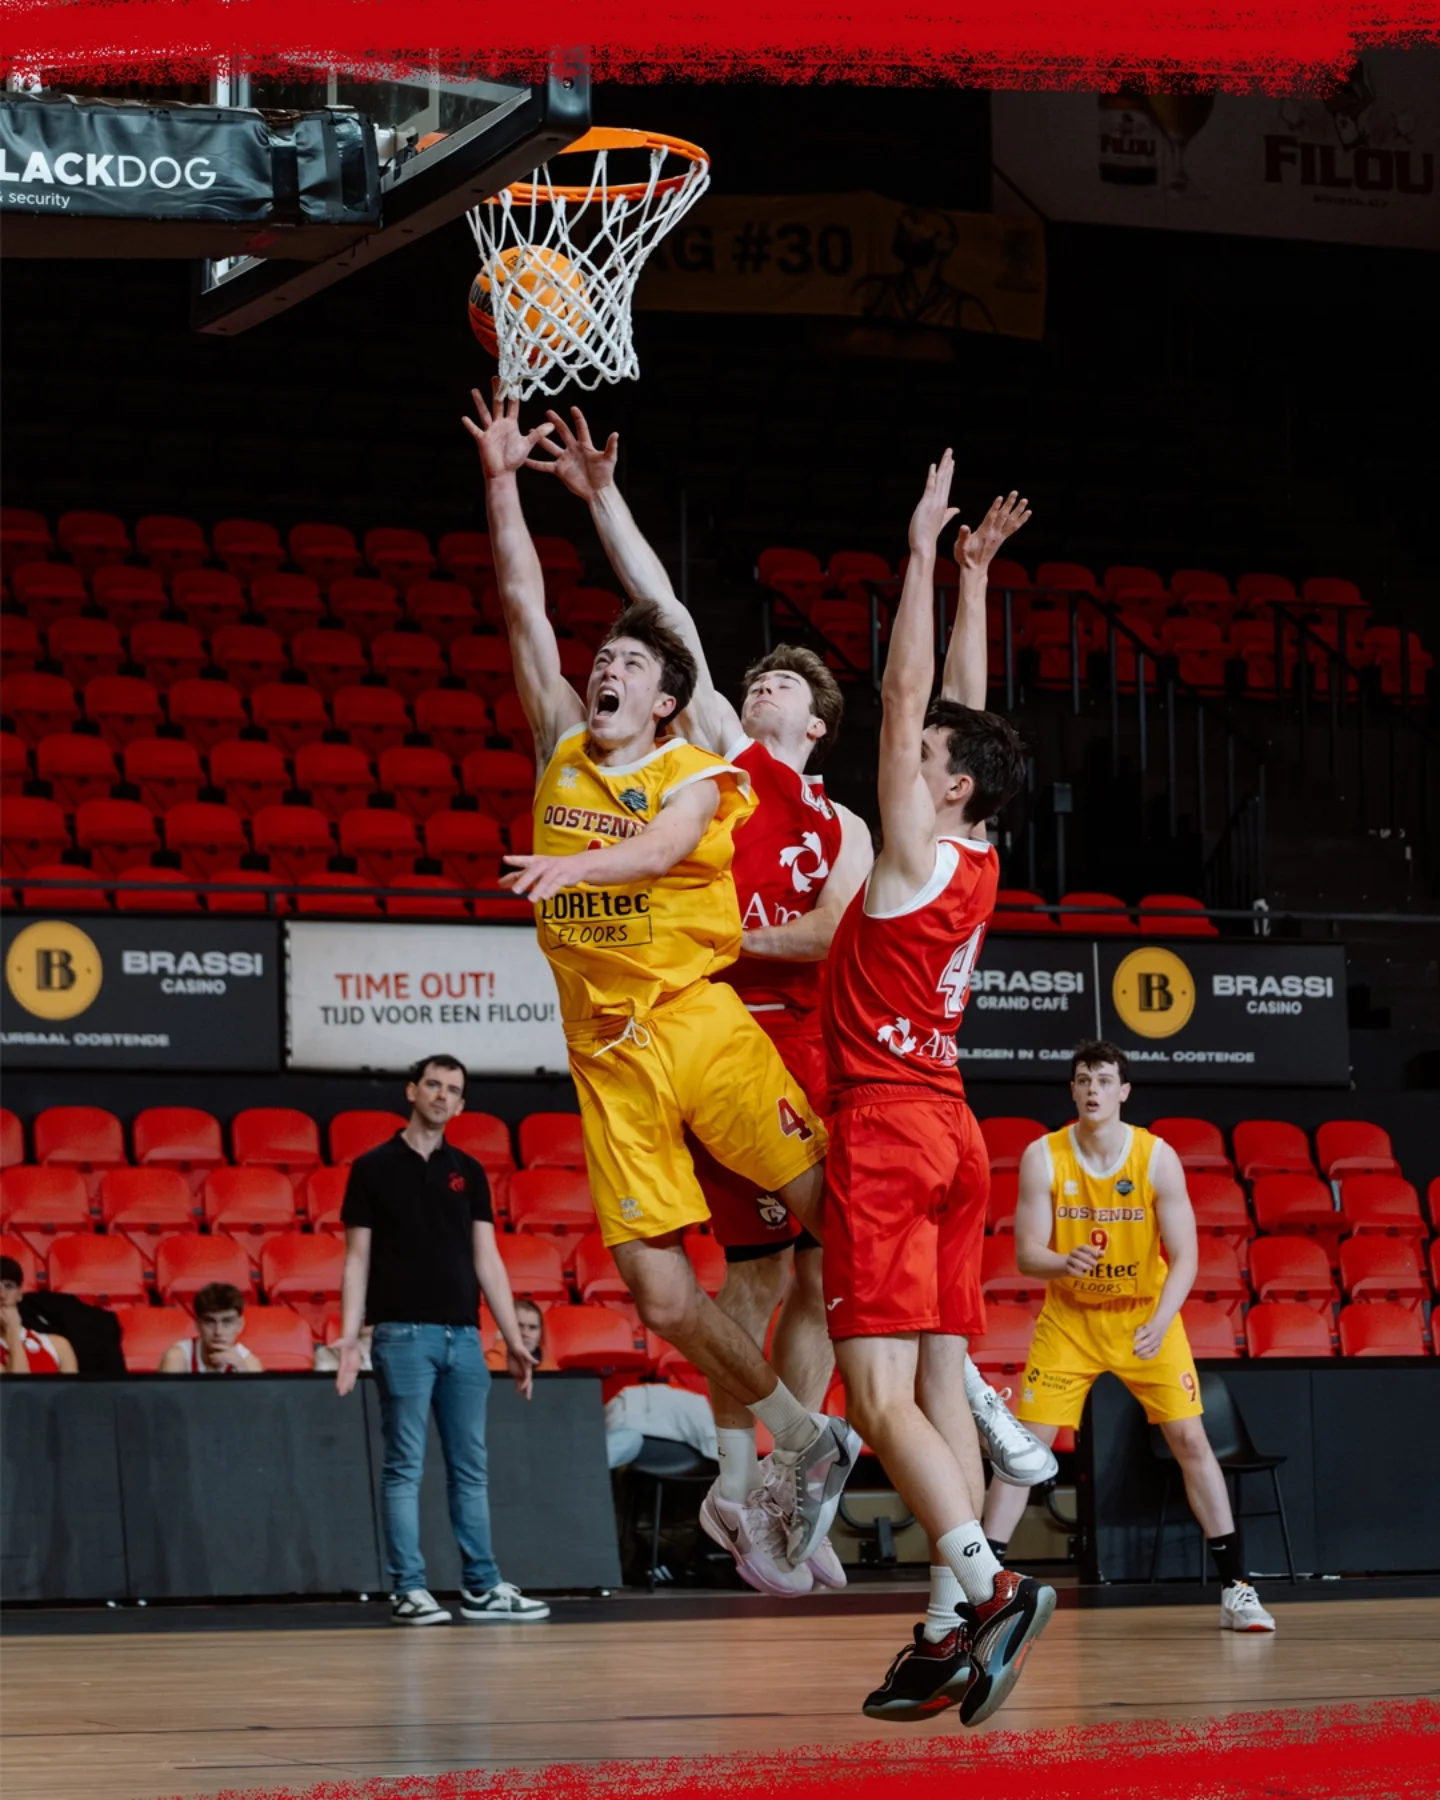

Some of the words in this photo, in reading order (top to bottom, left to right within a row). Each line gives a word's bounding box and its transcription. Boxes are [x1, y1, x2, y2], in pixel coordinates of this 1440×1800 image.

[0, 148, 217, 190] LACKDOG
[1263, 134, 1434, 195] FILOU
[8, 191, 71, 209] security
[732, 219, 854, 277] #30
[558, 924, 628, 943] FLOORS
[122, 950, 263, 976] BRASSI
[936, 921, 986, 1019] 4
[161, 978, 227, 995] CASINO
[334, 973, 410, 1001] TIME
[420, 971, 496, 999] OUT!
[1212, 974, 1334, 998] BRASSI
[320, 1005, 365, 1026] TIJD
[372, 1004, 433, 1025] VOOR
[440, 1003, 481, 1023] EEN
[488, 1002, 556, 1022] FILOU!
[976, 995, 1030, 1011] GRAND
[1032, 993, 1069, 1012] CAFÉ
[1246, 999, 1303, 1015] CASINO
[73, 1032, 170, 1048] OOSTENDE
[1018, 1049, 1034, 1060] IN
[1172, 1051, 1256, 1063] OOSTENDE
[776, 1096, 815, 1143] 4
[1057, 1205, 1145, 1223] OOSTENDE
[1073, 1280, 1122, 1294] FLOORS
[1180, 1372, 1198, 1403] 9
